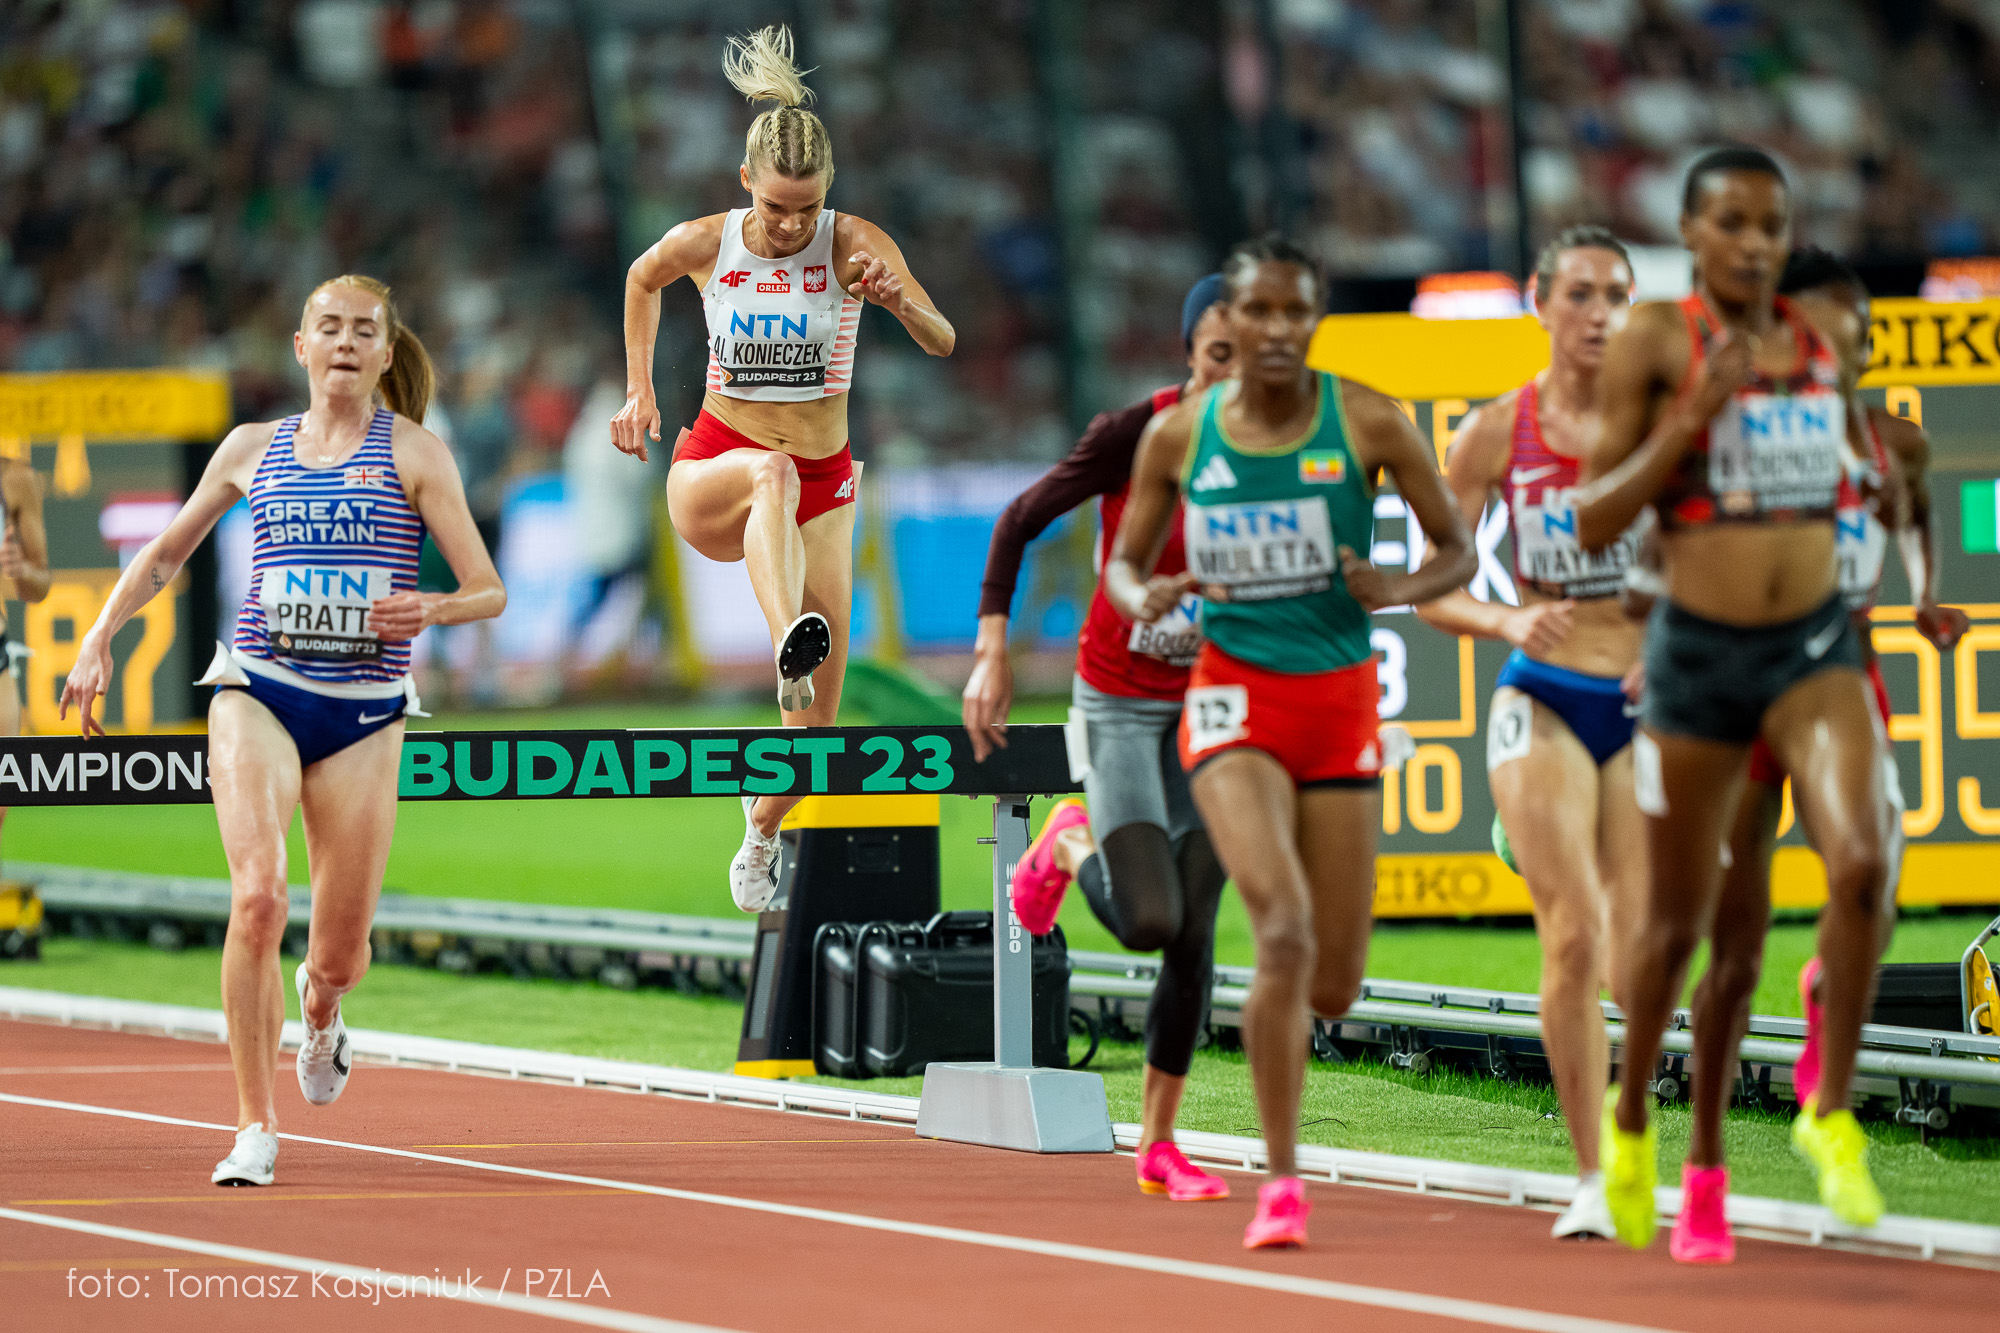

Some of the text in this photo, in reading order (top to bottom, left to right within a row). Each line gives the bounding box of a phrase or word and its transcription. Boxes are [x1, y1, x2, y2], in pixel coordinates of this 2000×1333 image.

[719, 270, 752, 288] 4F
[758, 284, 789, 293] ORLEN
[729, 308, 808, 340] NTN
[732, 341, 824, 366] KONIECZEK
[736, 371, 817, 382] BUDAPEST 23
[834, 475, 854, 499] 4F
[265, 501, 375, 523] GREAT
[1205, 503, 1299, 538] NTN
[268, 522, 377, 544] BRITAIN
[285, 568, 369, 600] NTN
[277, 602, 372, 634] PRATT
[294, 638, 377, 654] BUDAPEST 23
[399, 738, 845, 797] BUDAPEST
[860, 734, 956, 792] 23
